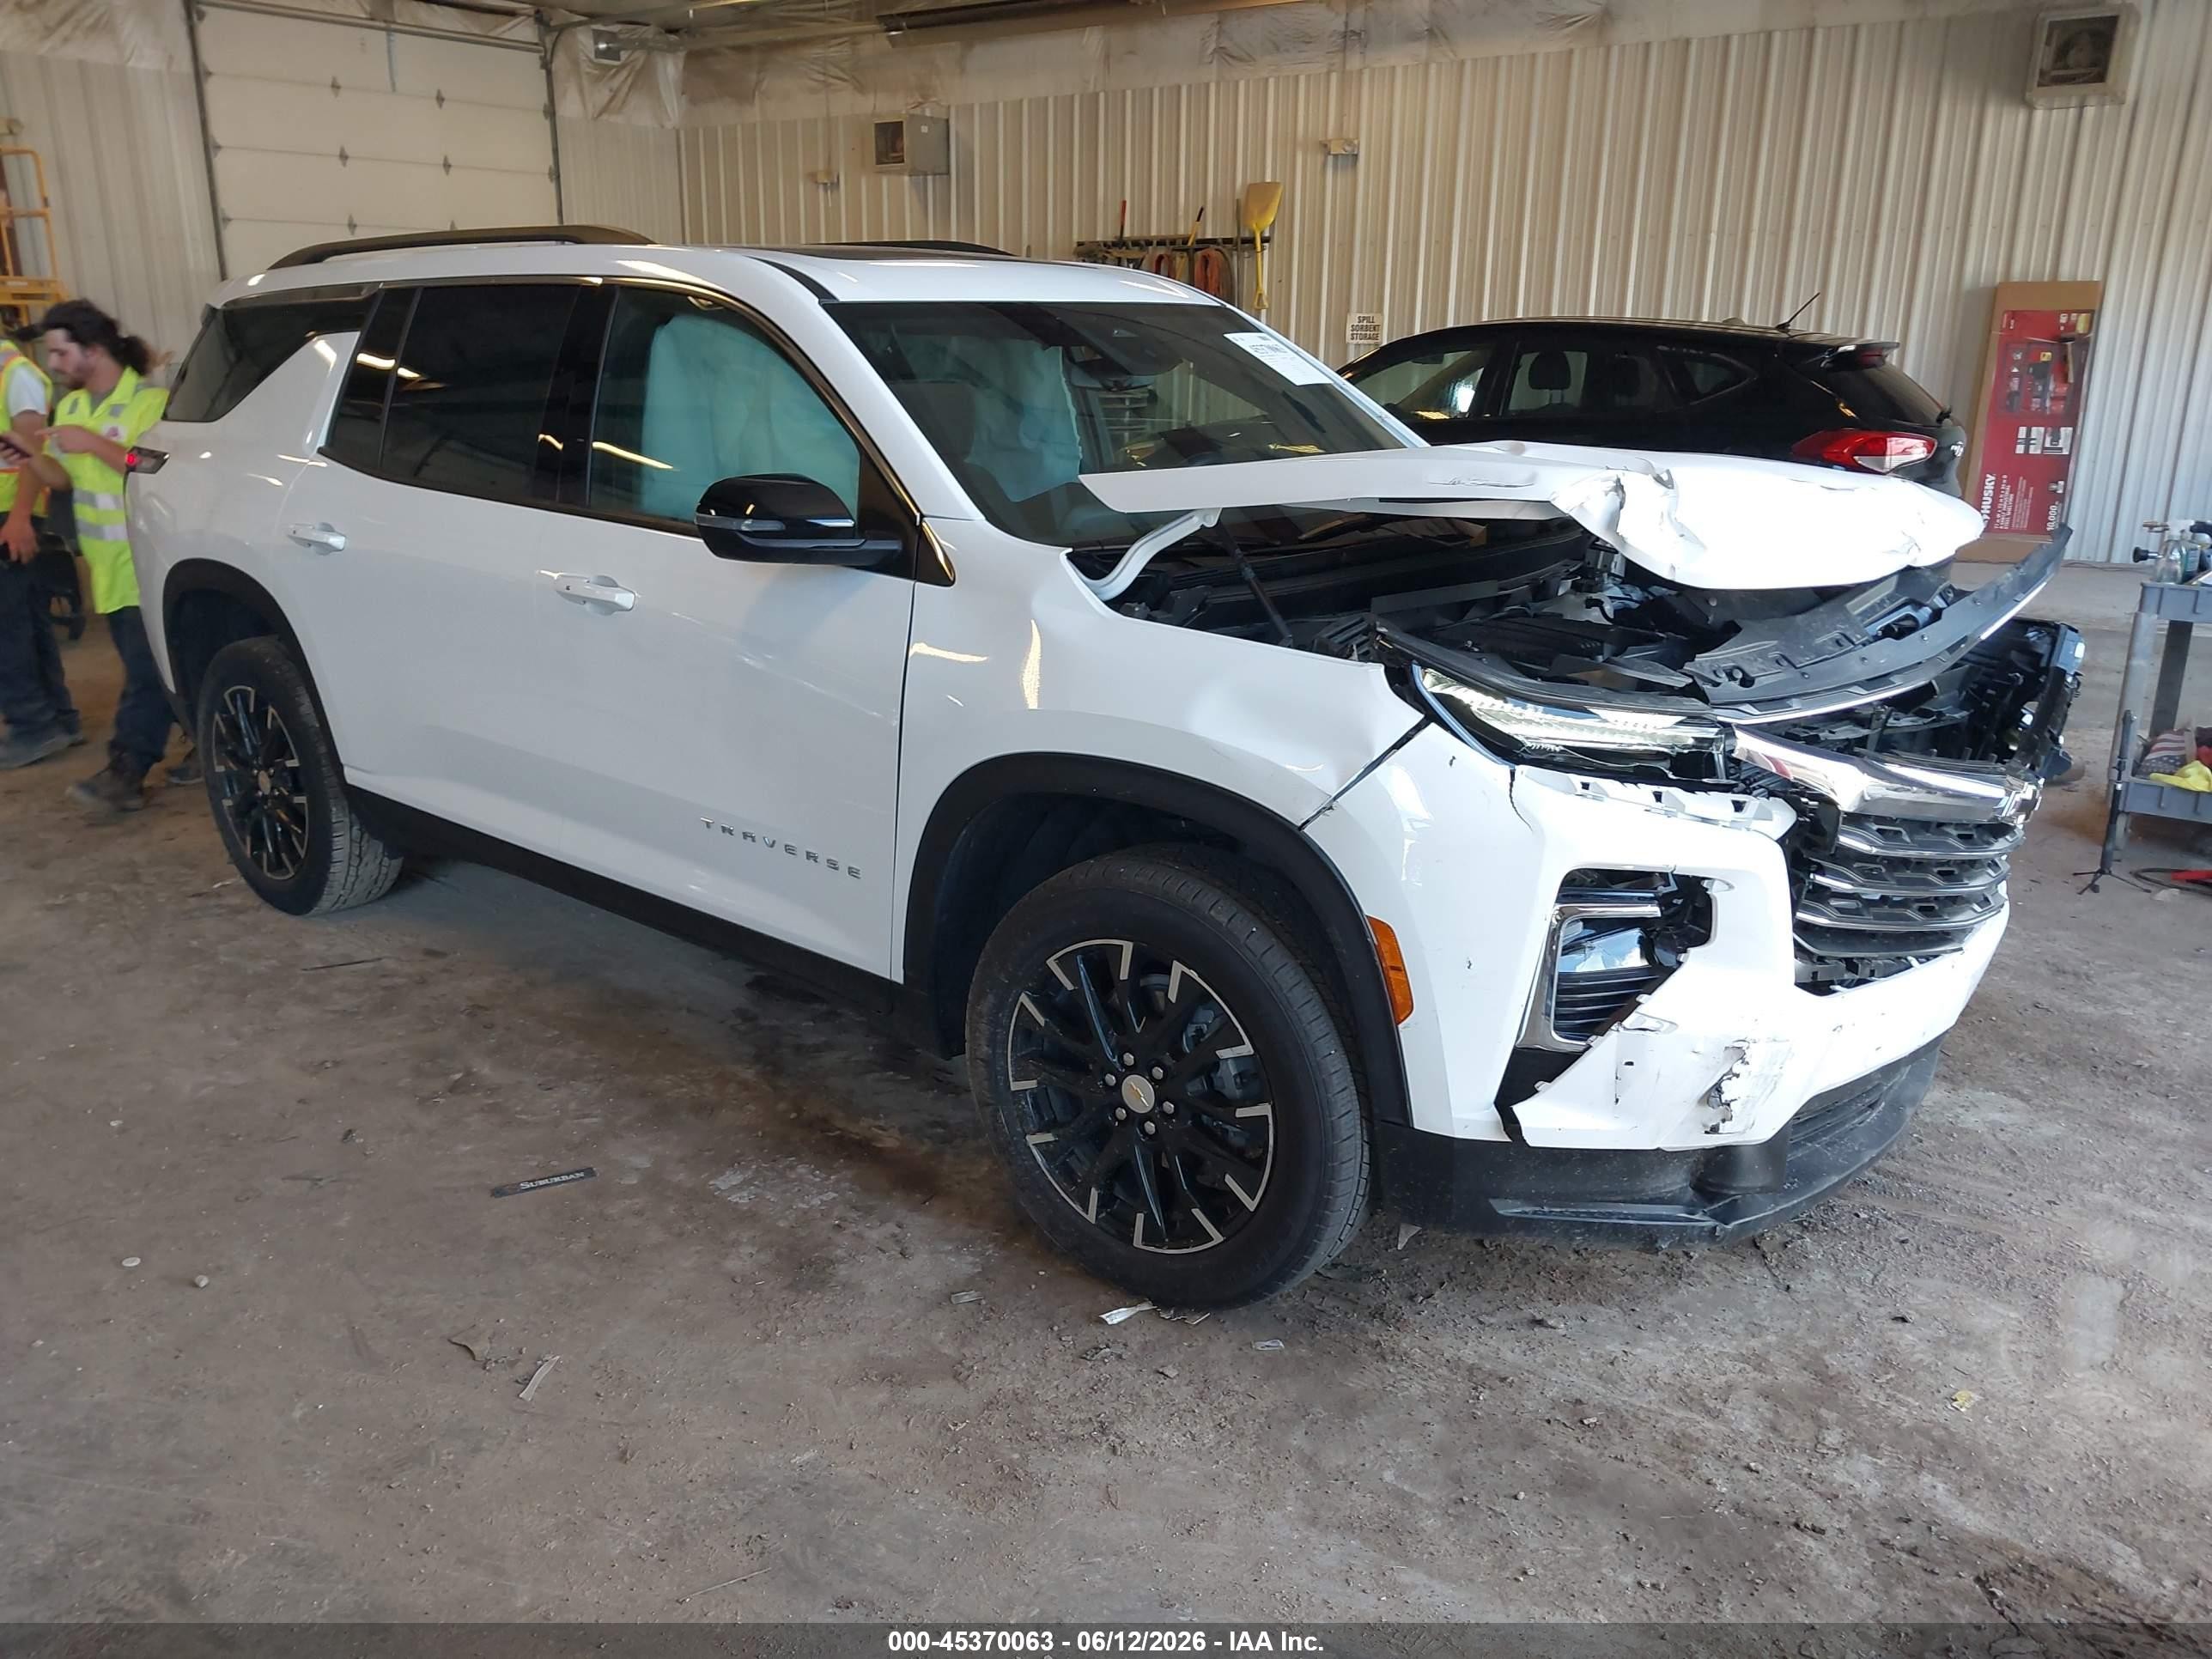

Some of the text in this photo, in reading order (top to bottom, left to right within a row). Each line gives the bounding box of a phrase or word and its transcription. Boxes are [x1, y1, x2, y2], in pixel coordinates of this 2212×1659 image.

[1981, 474, 1996, 514] HUSKY
[2046, 505, 2057, 531] 10,000
[700, 817, 862, 879] TRAVERSE
[520, 1171, 585, 1189] SUBURBAN
